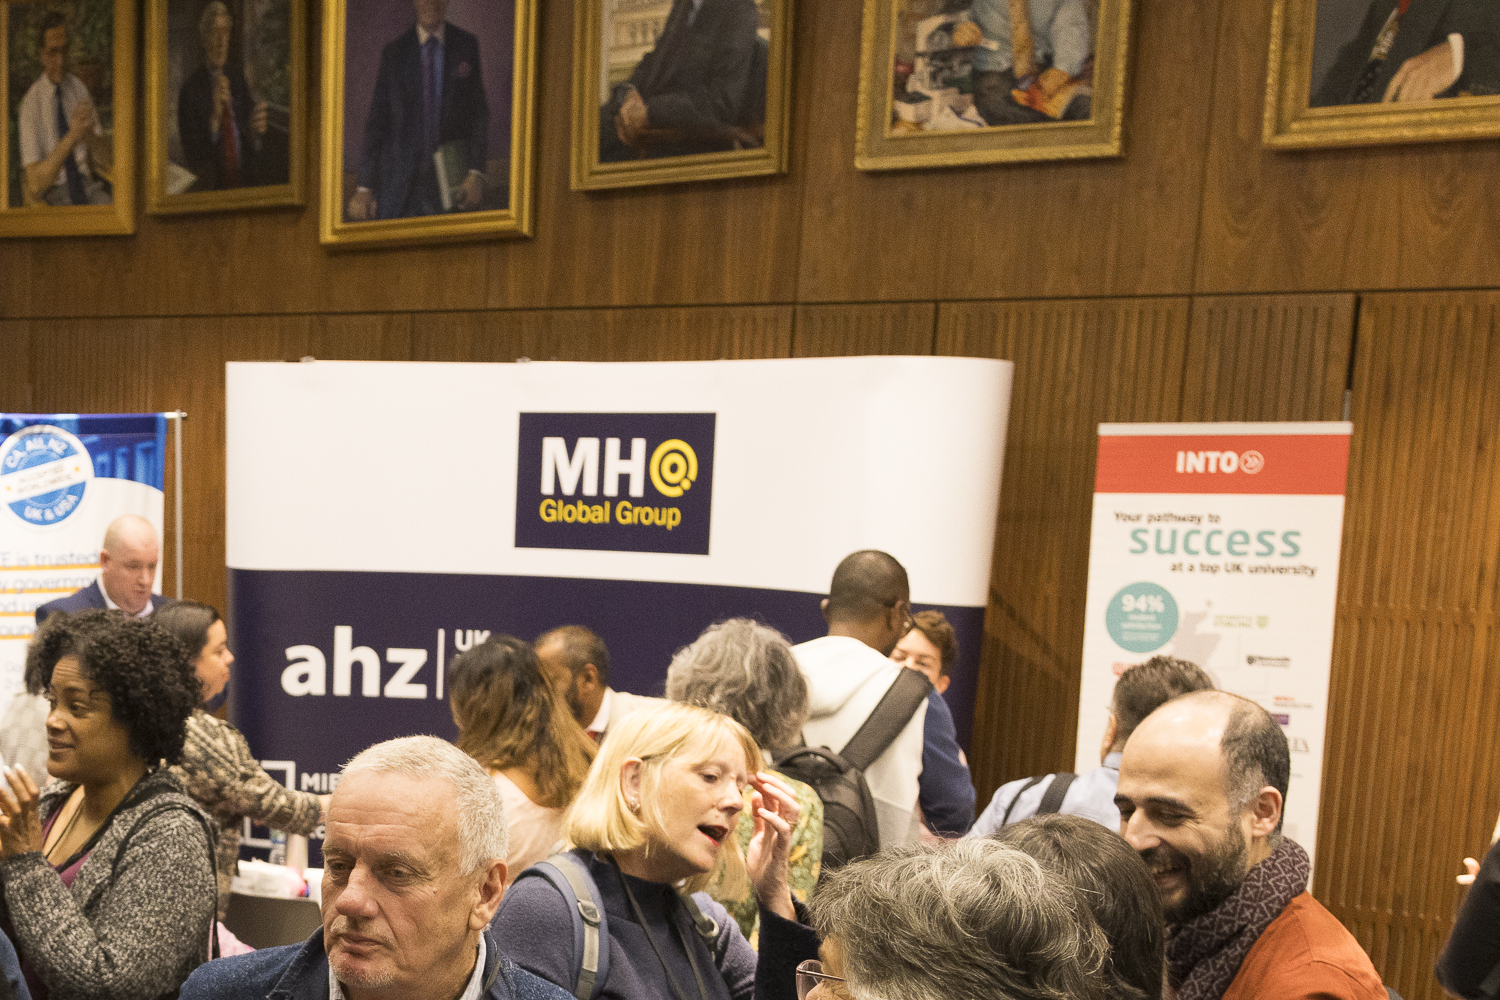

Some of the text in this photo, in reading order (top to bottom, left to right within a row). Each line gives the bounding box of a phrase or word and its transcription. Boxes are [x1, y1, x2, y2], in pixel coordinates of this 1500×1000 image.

[1175, 450, 1239, 474] INTO
[23, 505, 43, 521] UK
[53, 494, 79, 517] USA
[539, 498, 681, 531] Global Group
[1114, 511, 1221, 524] Your pathway to
[1130, 527, 1301, 558] success
[15, 551, 29, 566] is
[34, 550, 99, 565] trusted
[1171, 562, 1317, 578] at a top UK university
[12, 576, 94, 594] governm
[1121, 593, 1165, 614] 94%
[280, 625, 428, 699] ahz
